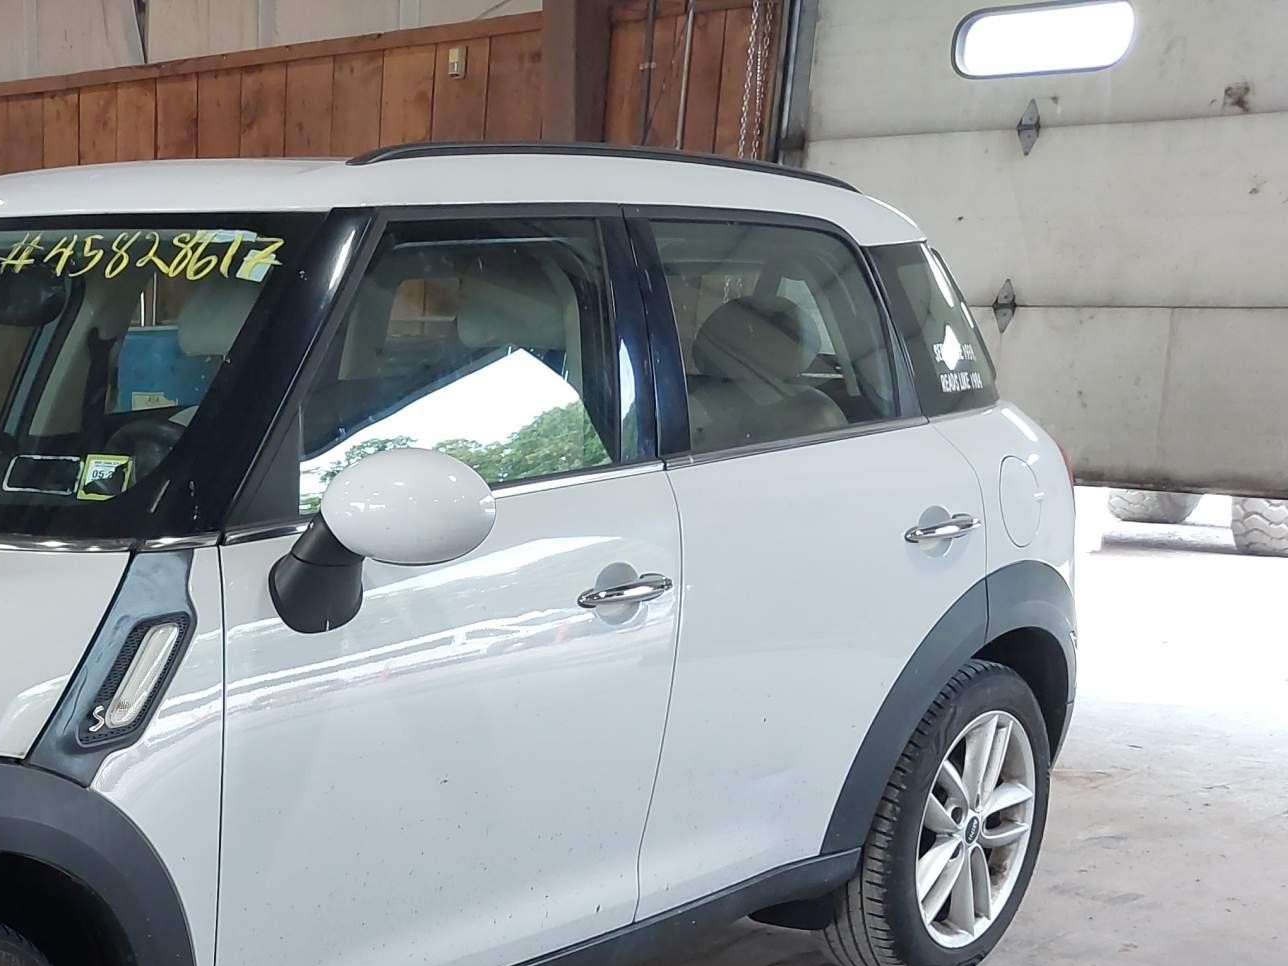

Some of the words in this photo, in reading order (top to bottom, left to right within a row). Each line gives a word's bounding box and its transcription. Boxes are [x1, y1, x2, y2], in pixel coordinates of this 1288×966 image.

[958, 372, 971, 390] LIKE
[88, 705, 105, 732] S
[968, 819, 978, 841] MINI
